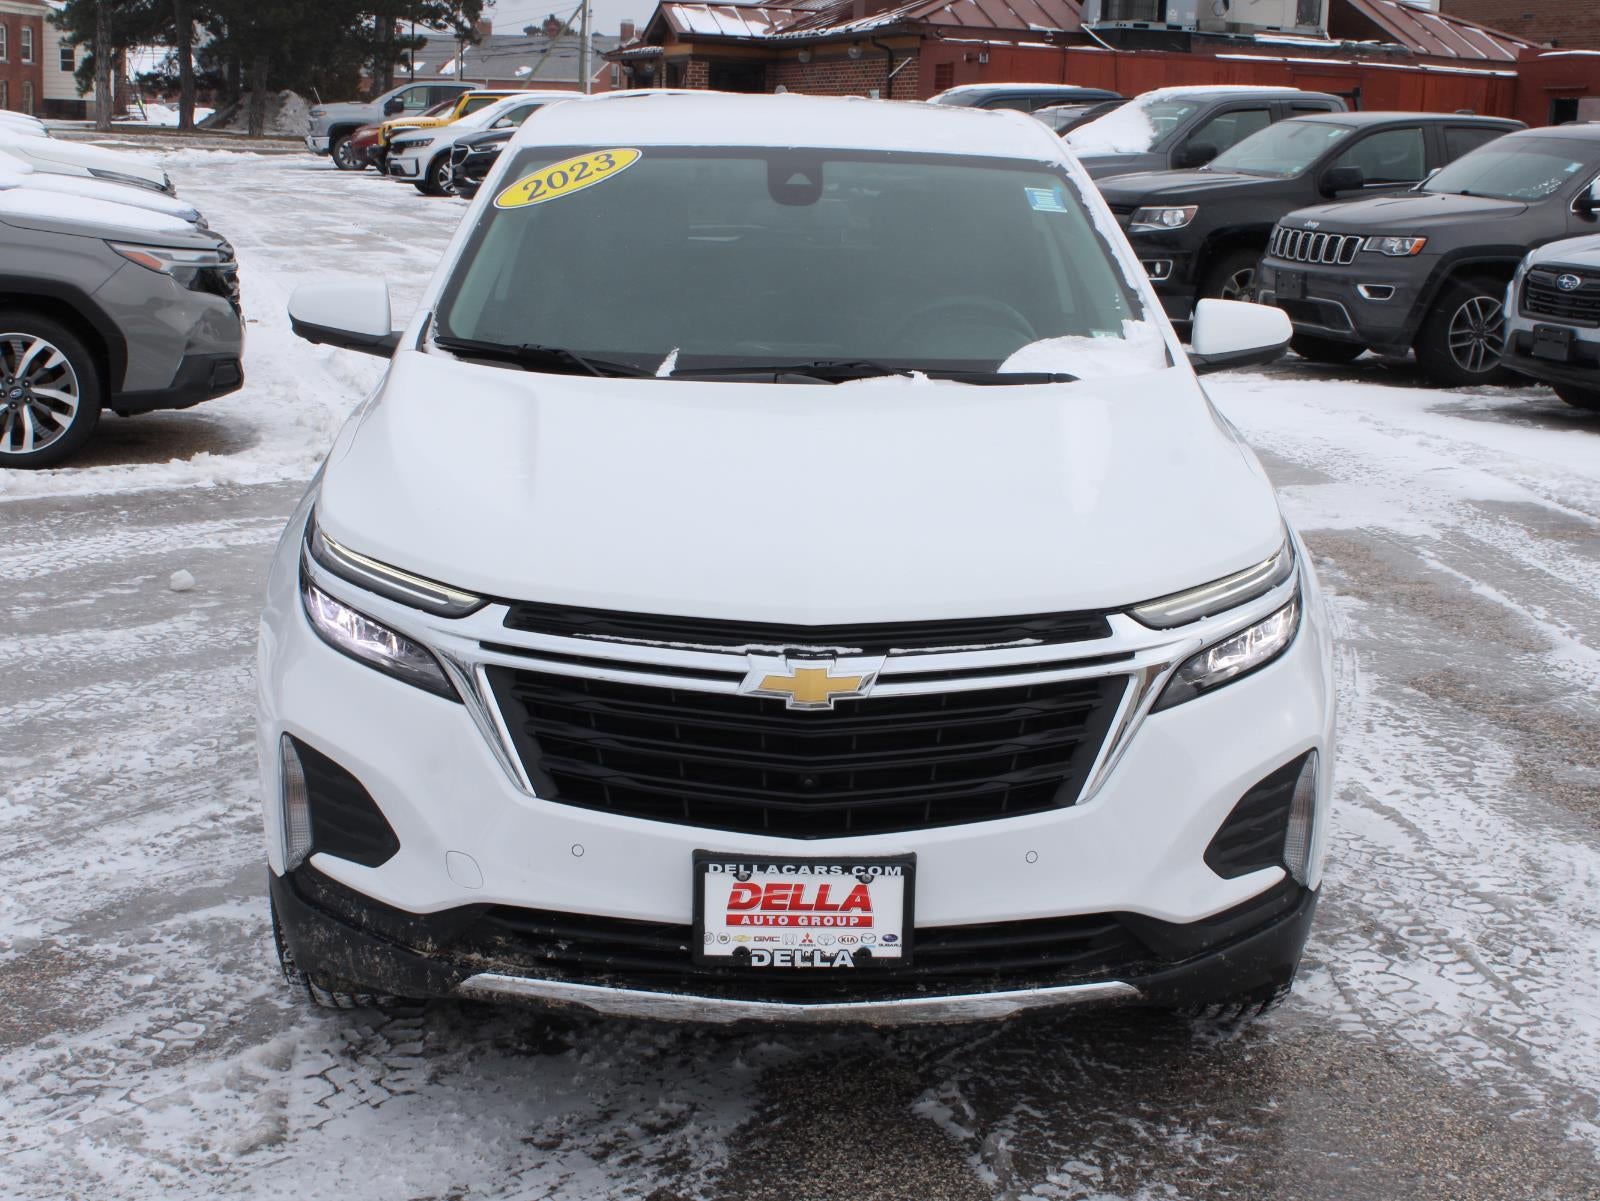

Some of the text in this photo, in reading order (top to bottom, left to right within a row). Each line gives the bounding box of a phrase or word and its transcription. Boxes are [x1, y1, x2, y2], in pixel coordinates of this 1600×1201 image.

[522, 152, 616, 201] 2023
[708, 863, 902, 877] DELLACARS.COM
[727, 882, 873, 912] DELLA
[741, 915, 860, 927] AUTO GROUP
[753, 935, 781, 943] GMC
[751, 949, 855, 967] DELLA
